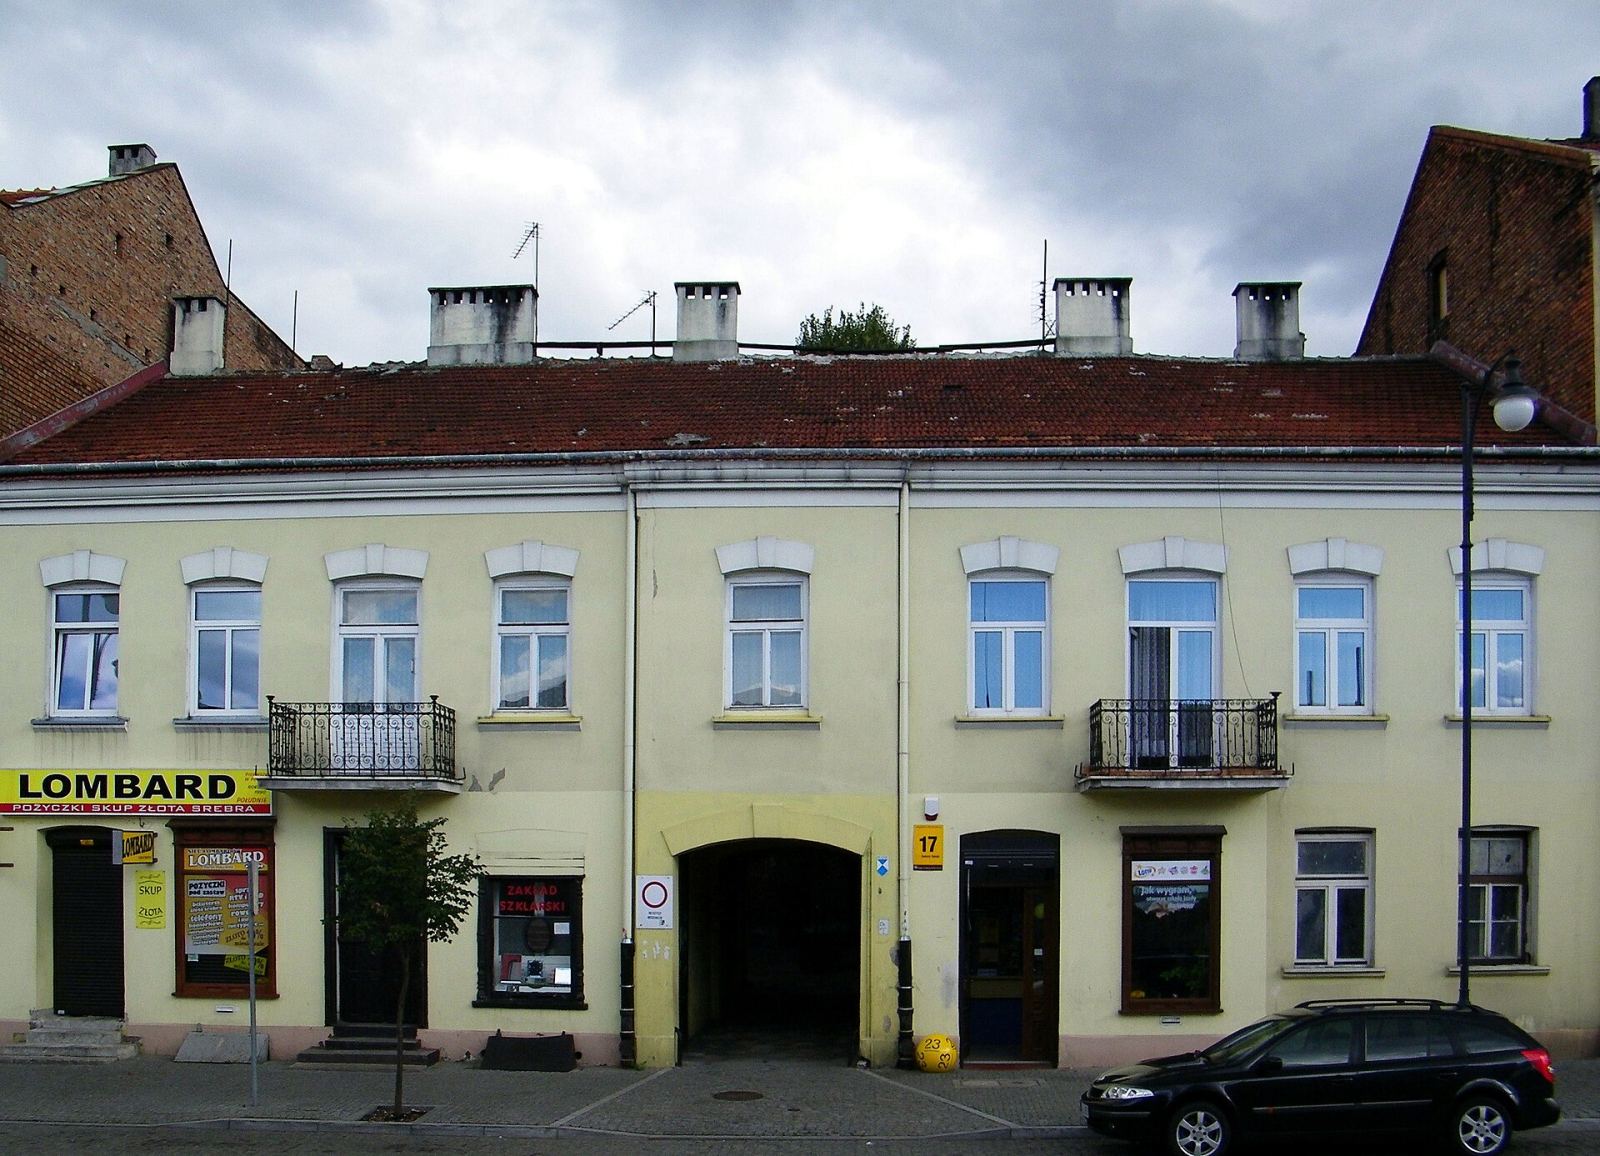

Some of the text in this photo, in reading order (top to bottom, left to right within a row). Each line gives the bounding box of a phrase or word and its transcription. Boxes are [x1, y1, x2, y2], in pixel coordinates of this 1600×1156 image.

[19, 774, 236, 799] LOMBARD
[191, 805, 255, 813] SREBRA
[122, 834, 153, 858] LOMBARD
[919, 836, 938, 853] 17
[189, 851, 264, 867] LOMBARD
[139, 885, 162, 895] SKUP
[507, 885, 558, 896] ZAKŁAD
[139, 907, 163, 917] ZŁOTA
[924, 1039, 940, 1049] 23
[938, 1053, 951, 1069] 23
